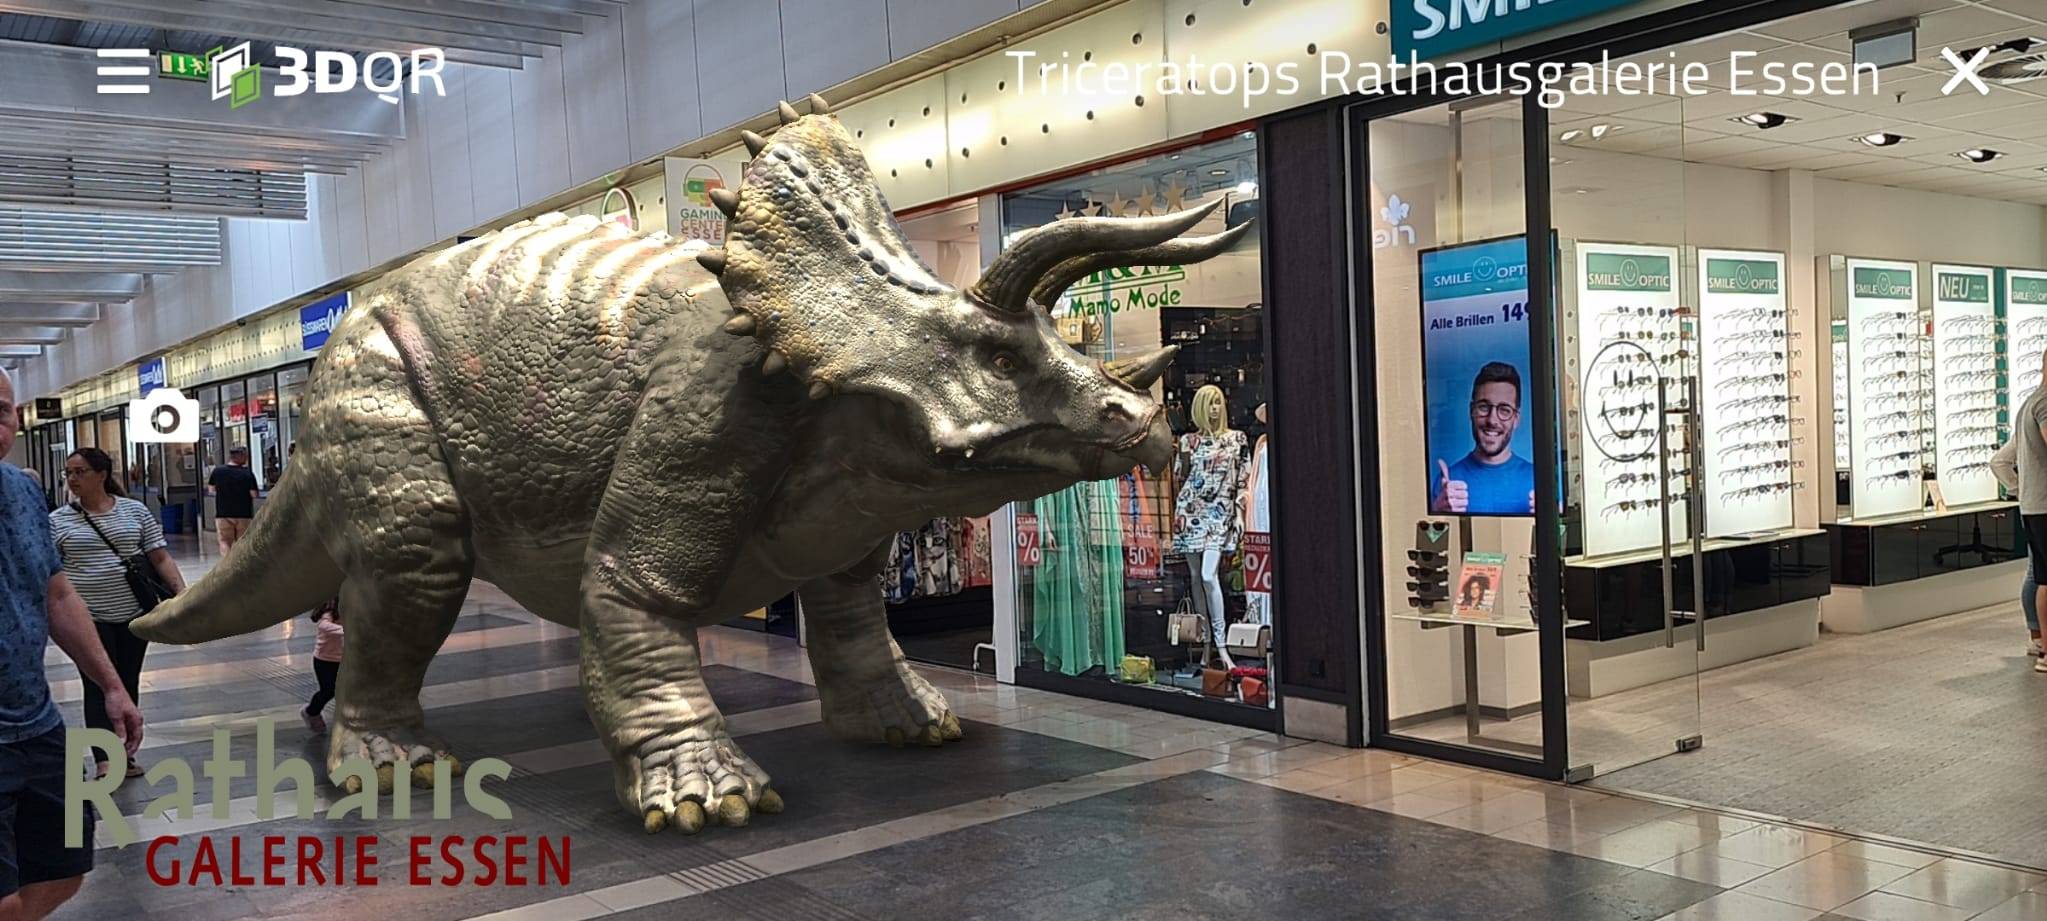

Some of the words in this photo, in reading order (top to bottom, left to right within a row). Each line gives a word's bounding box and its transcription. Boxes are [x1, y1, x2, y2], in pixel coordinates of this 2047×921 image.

[680, 208, 727, 219] GAMIN
[680, 218, 726, 230] CENTE
[1433, 272, 1473, 287] SMILE
[1496, 264, 1528, 279] OPT
[1588, 273, 1620, 286] SMILE
[1638, 274, 1669, 287] OPTIC
[1708, 277, 1736, 289] SMILE
[1750, 279, 1777, 290] OPTIC
[1889, 285, 1912, 296] OPTIC
[1940, 275, 1969, 299] NEU
[1068, 296, 1121, 319] Mamo
[1126, 284, 1181, 311] Mode
[1430, 318, 1453, 331] Alle
[1456, 314, 1494, 328] Brillen
[1127, 523, 1153, 538] SALE
